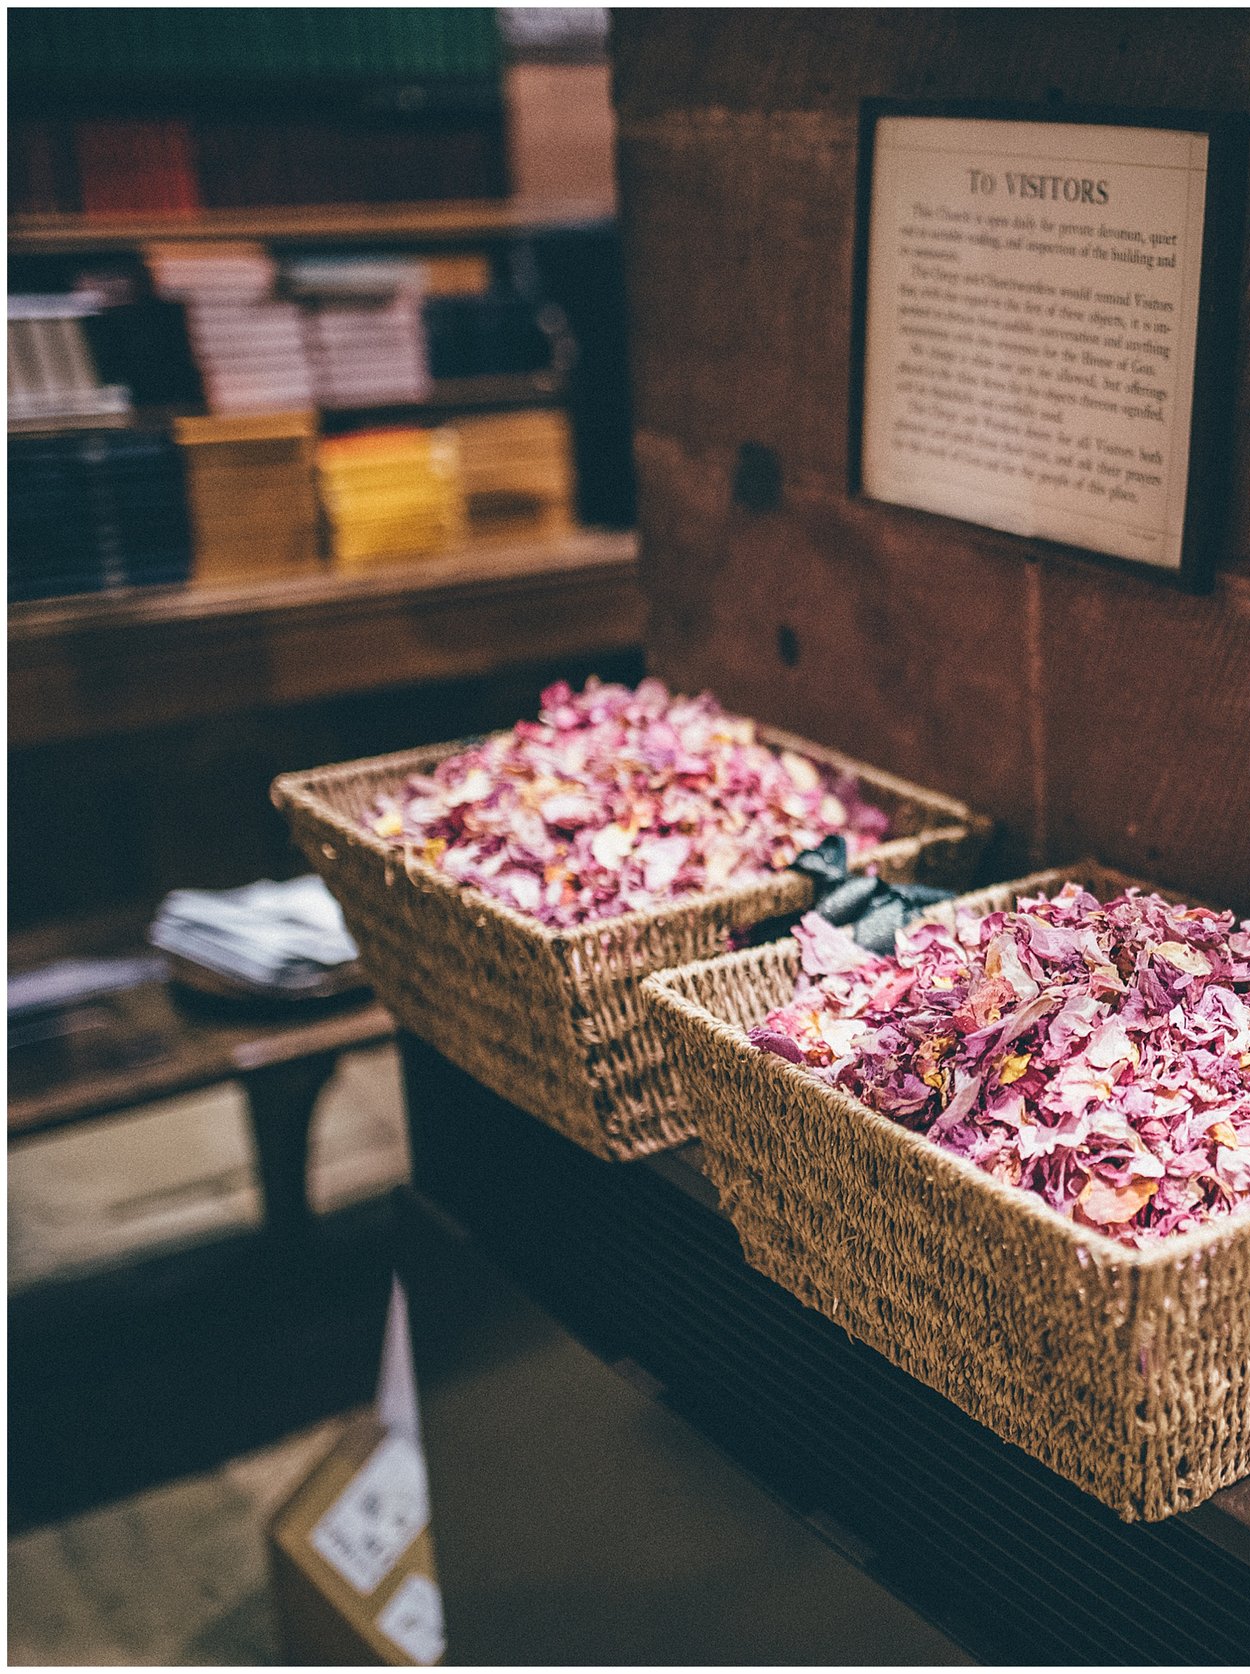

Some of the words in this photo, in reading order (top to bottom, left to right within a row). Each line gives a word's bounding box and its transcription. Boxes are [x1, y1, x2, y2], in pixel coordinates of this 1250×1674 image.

[1004, 172, 1110, 205] VISITORS
[1148, 232, 1177, 249] quiet
[1110, 247, 1154, 271] building
[1156, 252, 1176, 268] and
[1134, 292, 1174, 312] Visitors
